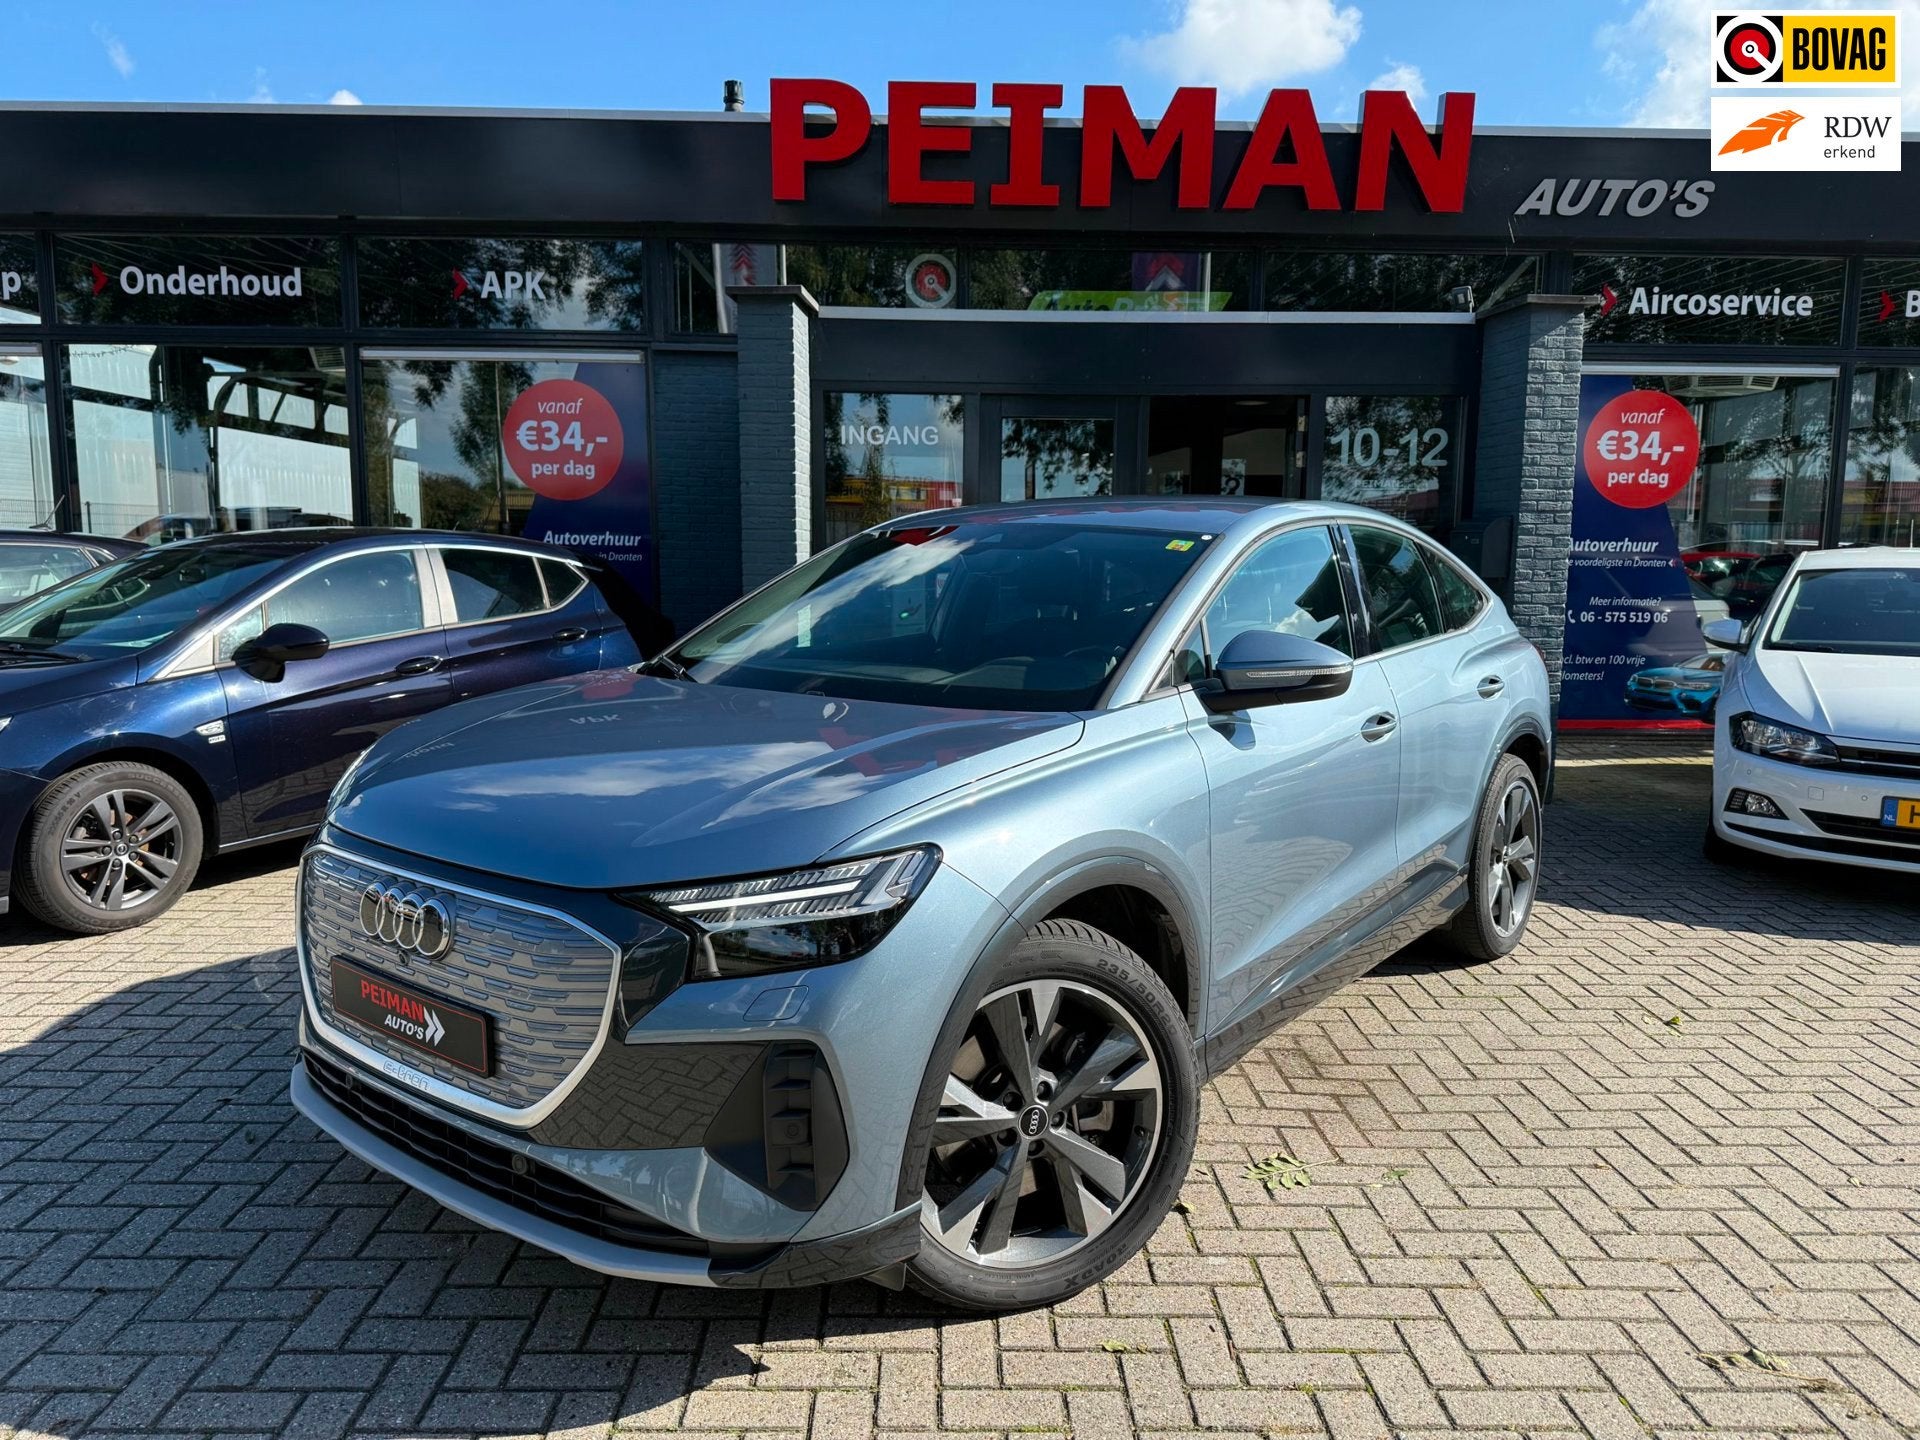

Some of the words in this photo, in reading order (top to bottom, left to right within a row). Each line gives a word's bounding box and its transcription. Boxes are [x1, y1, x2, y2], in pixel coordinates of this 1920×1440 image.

[769, 78, 1476, 213] PEIMAN
[1514, 178, 1716, 218] AUTO'S
[119, 265, 303, 297] Onderhoud
[480, 270, 546, 299] APK
[1628, 286, 1814, 316] Aircoservice
[537, 398, 584, 415] vanaf
[1621, 408, 1666, 424] vanaf
[516, 420, 608, 457] €34,-
[840, 425, 939, 446] INGANG
[1330, 427, 1449, 467] 10-12
[1596, 430, 1685, 466] €34,-
[531, 462, 559, 479] per
[563, 459, 596, 480] dag
[1607, 472, 1635, 488] per
[1638, 468, 1669, 488] dag
[543, 530, 641, 547] Autoverhuur
[608, 552, 643, 562] Dronten
[1574, 557, 1623, 569] voordeligste
[1624, 557, 1632, 567] in
[1633, 557, 1667, 568] Dronten
[1589, 596, 1611, 606] Meer
[1612, 596, 1661, 607] informatie?
[1580, 611, 1595, 622] 06
[1604, 612, 1627, 623] 575
[1628, 612, 1651, 623] 519
[1653, 612, 1669, 623] 06
[1575, 655, 1594, 665] btw
[1595, 656, 1606, 665] en
[1608, 655, 1626, 664] 100
[1626, 655, 1646, 667] vrije
[1561, 671, 1604, 681] lometers!
[361, 979, 424, 1024] PEIMAN
[384, 1013, 424, 1040] AUTO'S
